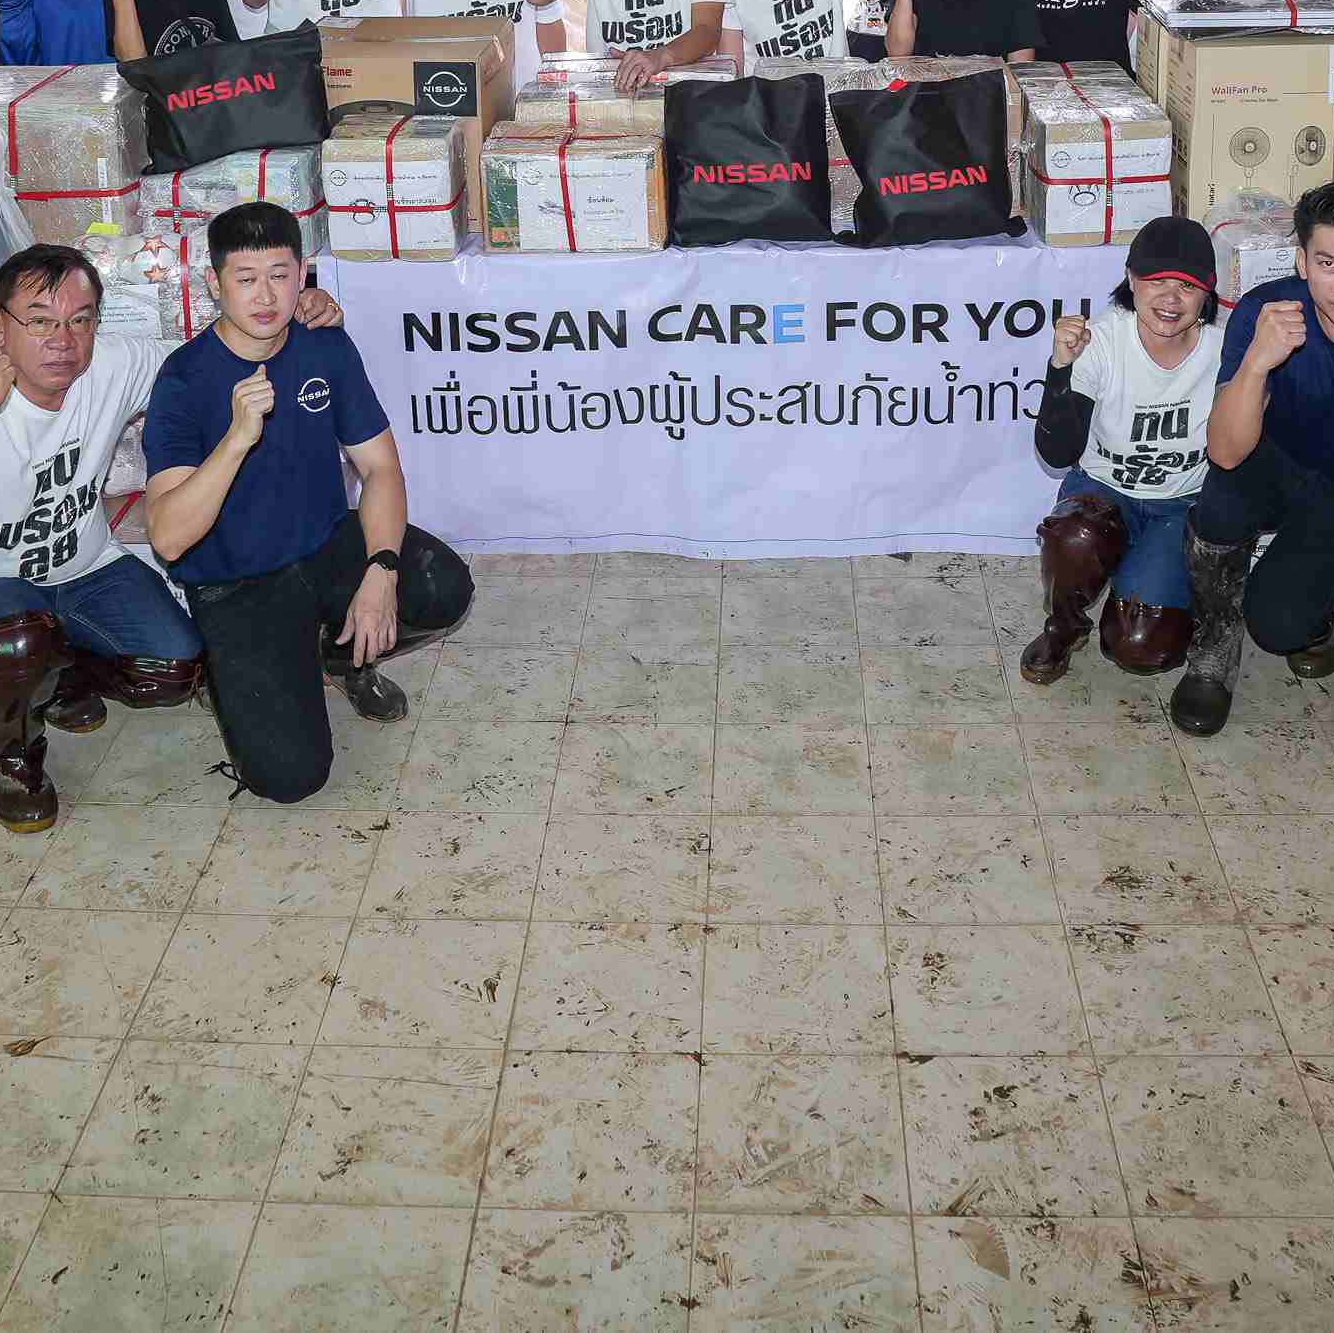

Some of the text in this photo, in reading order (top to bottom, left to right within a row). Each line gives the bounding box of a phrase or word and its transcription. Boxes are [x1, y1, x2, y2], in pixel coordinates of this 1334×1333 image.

[167, 73, 275, 112] NISSAN
[423, 85, 468, 94] NISSAN
[693, 161, 812, 186] NISSAN
[878, 165, 988, 197] NISSAN
[403, 308, 628, 352] NISSAN
[648, 302, 805, 346] CARE
[826, 300, 950, 344] FOR
[409, 361, 1045, 441] เพื่อพี่น้องผู้ประสบภัยน้ำท่ว
[1130, 407, 1189, 442] ทน
